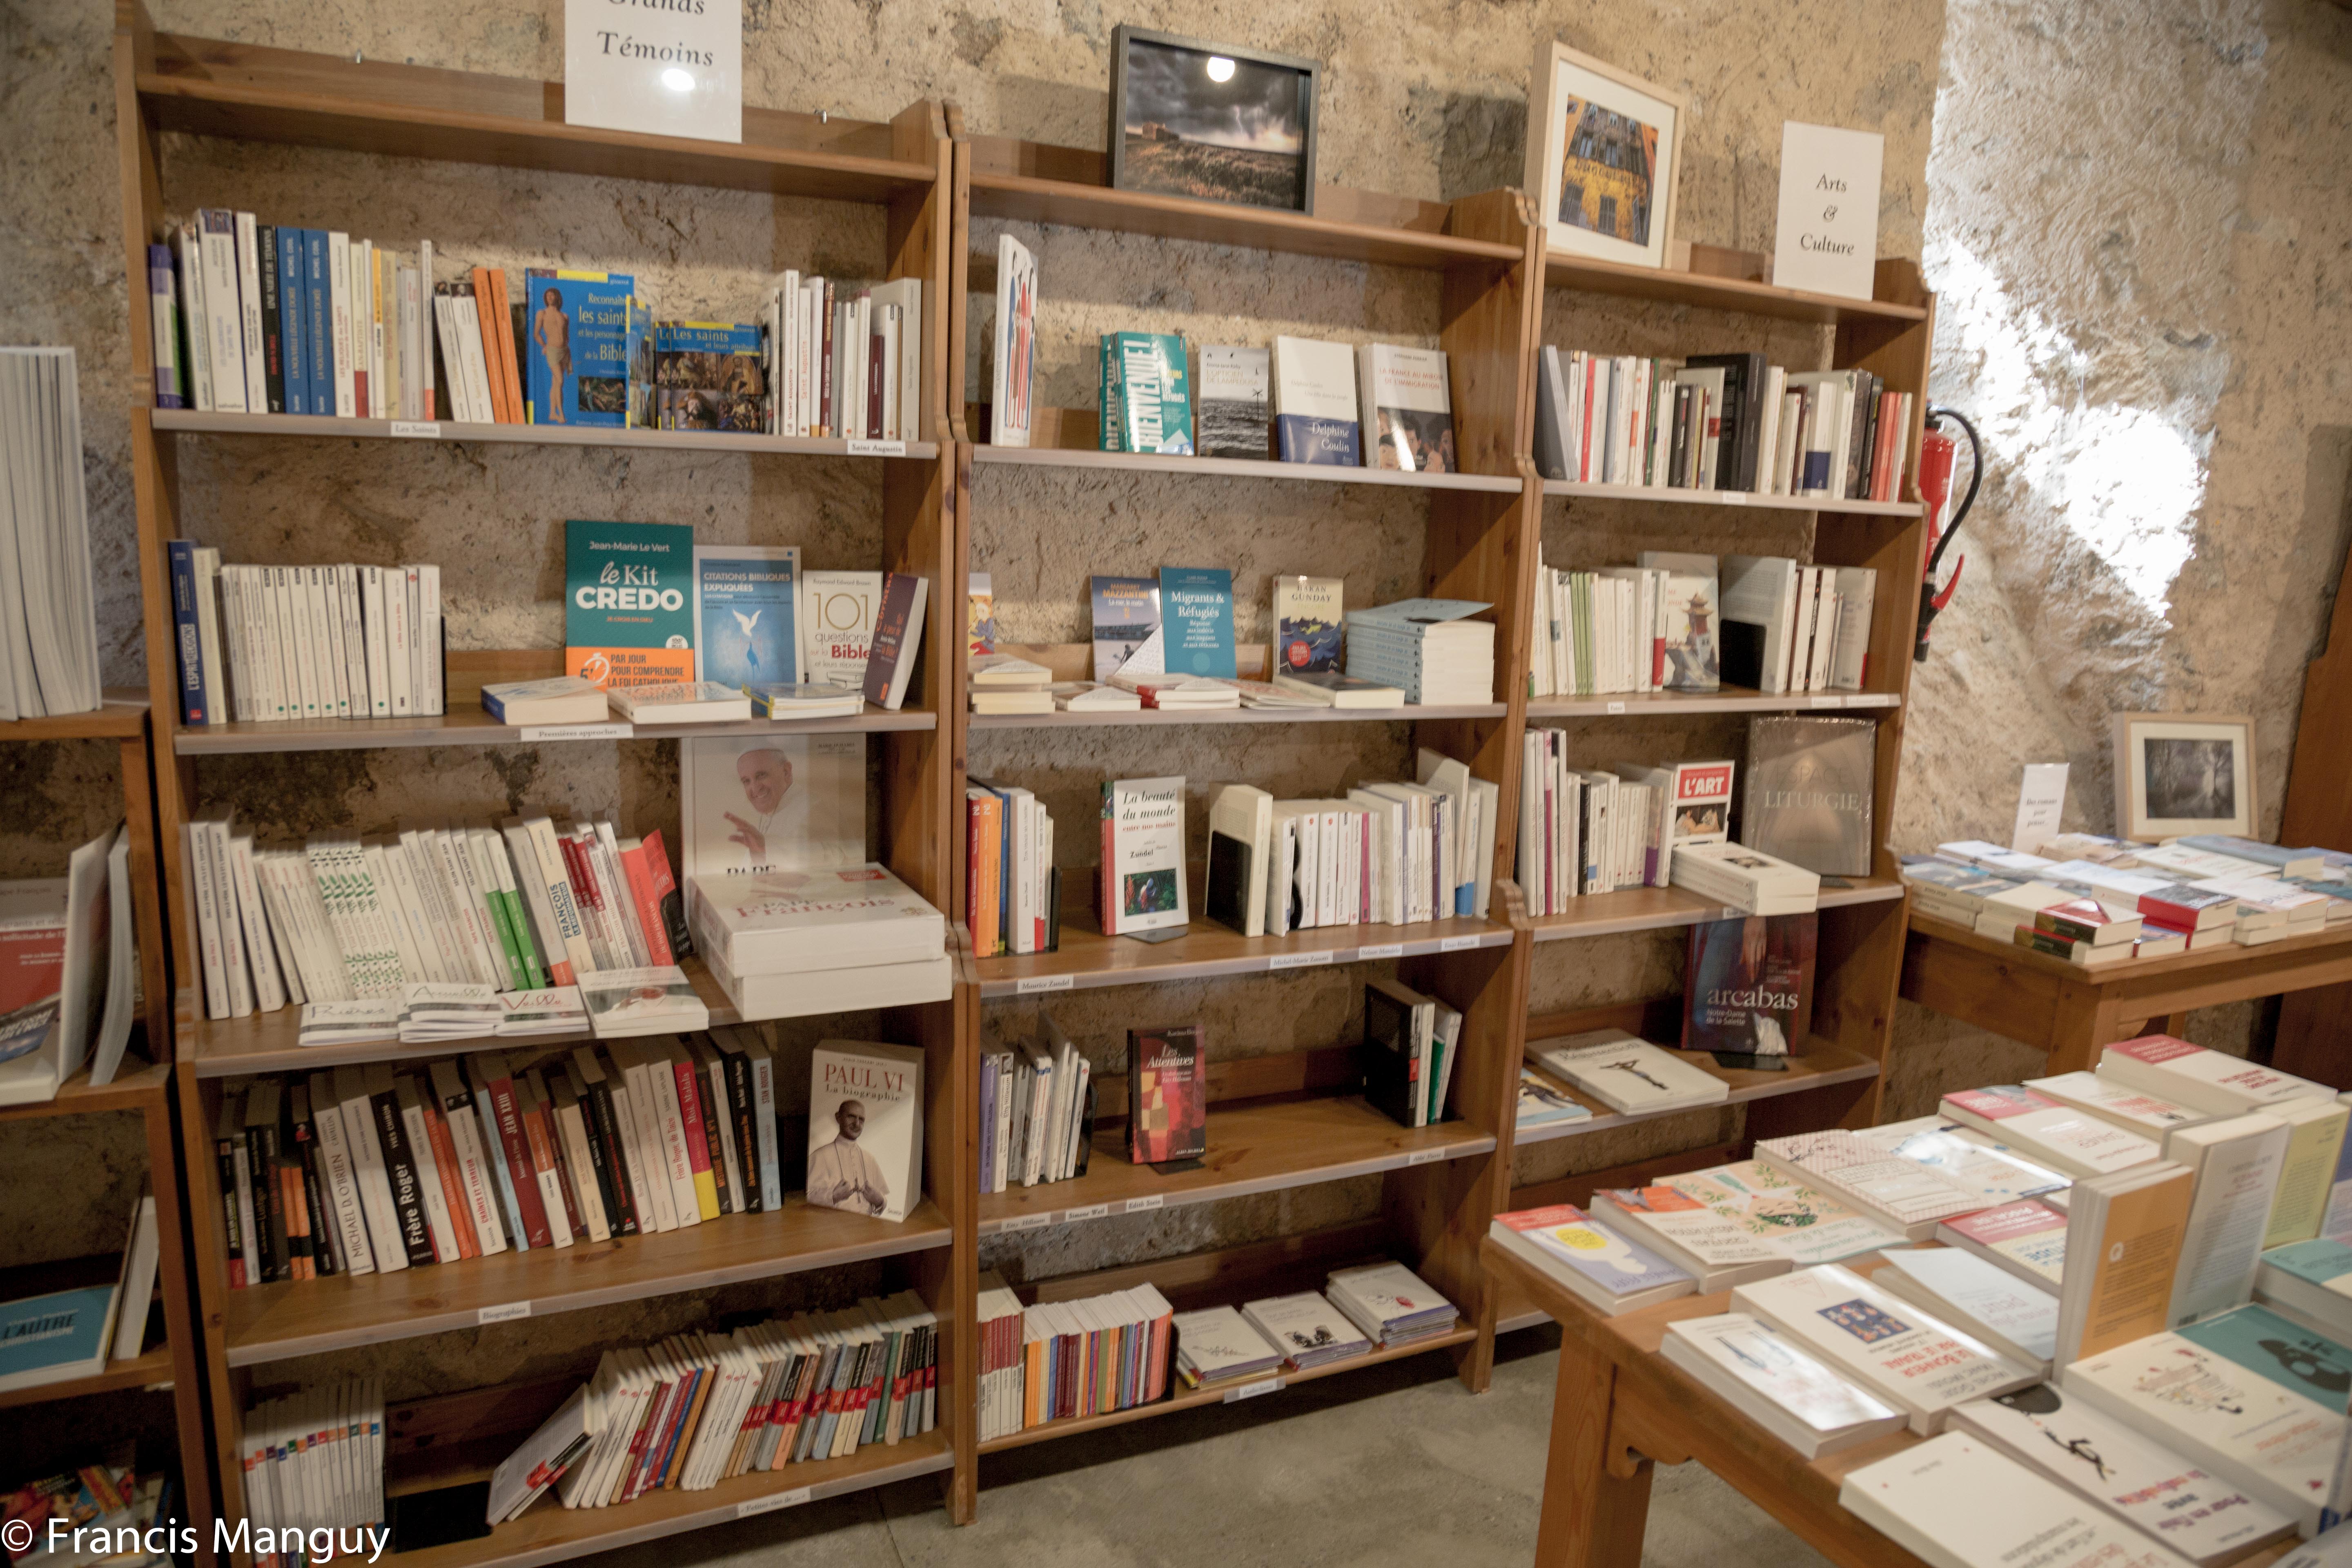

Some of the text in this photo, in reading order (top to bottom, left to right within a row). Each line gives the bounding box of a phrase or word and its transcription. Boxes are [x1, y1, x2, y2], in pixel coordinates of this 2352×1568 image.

[609, 0, 705, 15] ands
[597, 30, 713, 67] Témoins
[1816, 173, 1847, 194] Arts
[1823, 205, 1838, 222] &
[1801, 232, 1854, 256] Culture
[579, 305, 626, 325] les saints
[595, 330, 626, 340] personnage
[673, 327, 729, 342] Les saints
[600, 343, 626, 361] Bible
[1388, 368, 1410, 378] FRANCE
[1412, 370, 1421, 379] AU
[410, 425, 437, 434] Saints
[1312, 422, 1349, 438] Delphine
[873, 445, 903, 455] Augustin
[1321, 439, 1350, 452] Coulin
[589, 540, 670, 552] Jean-Marie Le Vert
[601, 561, 658, 586] le Kit
[704, 572, 791, 583] CITATIONS BIBLIQUES
[704, 581, 753, 592] EXPLIQUÉES
[576, 586, 683, 611] CREDO
[1171, 591, 1224, 605] Migrants &
[813, 592, 869, 631] 101
[1178, 605, 1219, 619] Réfugiés
[815, 631, 869, 645] questions
[611, 654, 646, 664] PAR JOUR
[823, 648, 829, 656] la
[831, 644, 871, 660] Bible
[611, 666, 685, 677] POUR COMPRENDRE
[608, 677, 617, 687] LA
[619, 677, 631, 687] FOI
[538, 728, 617, 738] Premières approches
[1685, 777, 1724, 797] L'ART
[1123, 788, 1176, 805] La beauté
[1764, 790, 1861, 812] LITURGIE
[2026, 797, 2036, 806] Des
[1122, 806, 1176, 820] du monde
[2034, 808, 2047, 817] pour
[1122, 823, 1139, 832] entre
[1155, 820, 1176, 829] mains
[1129, 849, 1154, 860] Zundel
[550, 884, 572, 939] FRANÇOIS
[1361, 947, 1401, 957] Nelson Mandela
[1022, 978, 1069, 990] Maurice Zundel
[1706, 985, 1799, 1011] arcabas
[1706, 1008, 1746, 1019] Notre-Dame
[1161, 1045, 1178, 1058] Les
[1147, 1055, 1194, 1069] Attentives
[824, 1064, 904, 1092] PAUL VI
[826, 1084, 900, 1102] La biographie
[498, 1092, 518, 1134] JEAN XXIII
[334, 1153, 350, 1194] O'BRIEN
[395, 1164, 422, 1247] Frère Roger
[1128, 1198, 1161, 1209] Edith Stein
[1068, 1207, 1105, 1220] Simone Weil
[345, 1212, 362, 1258] MICHAEL
[483, 1307, 526, 1320] Biographies
[745, 1497, 792, 1513] Petites vies de
